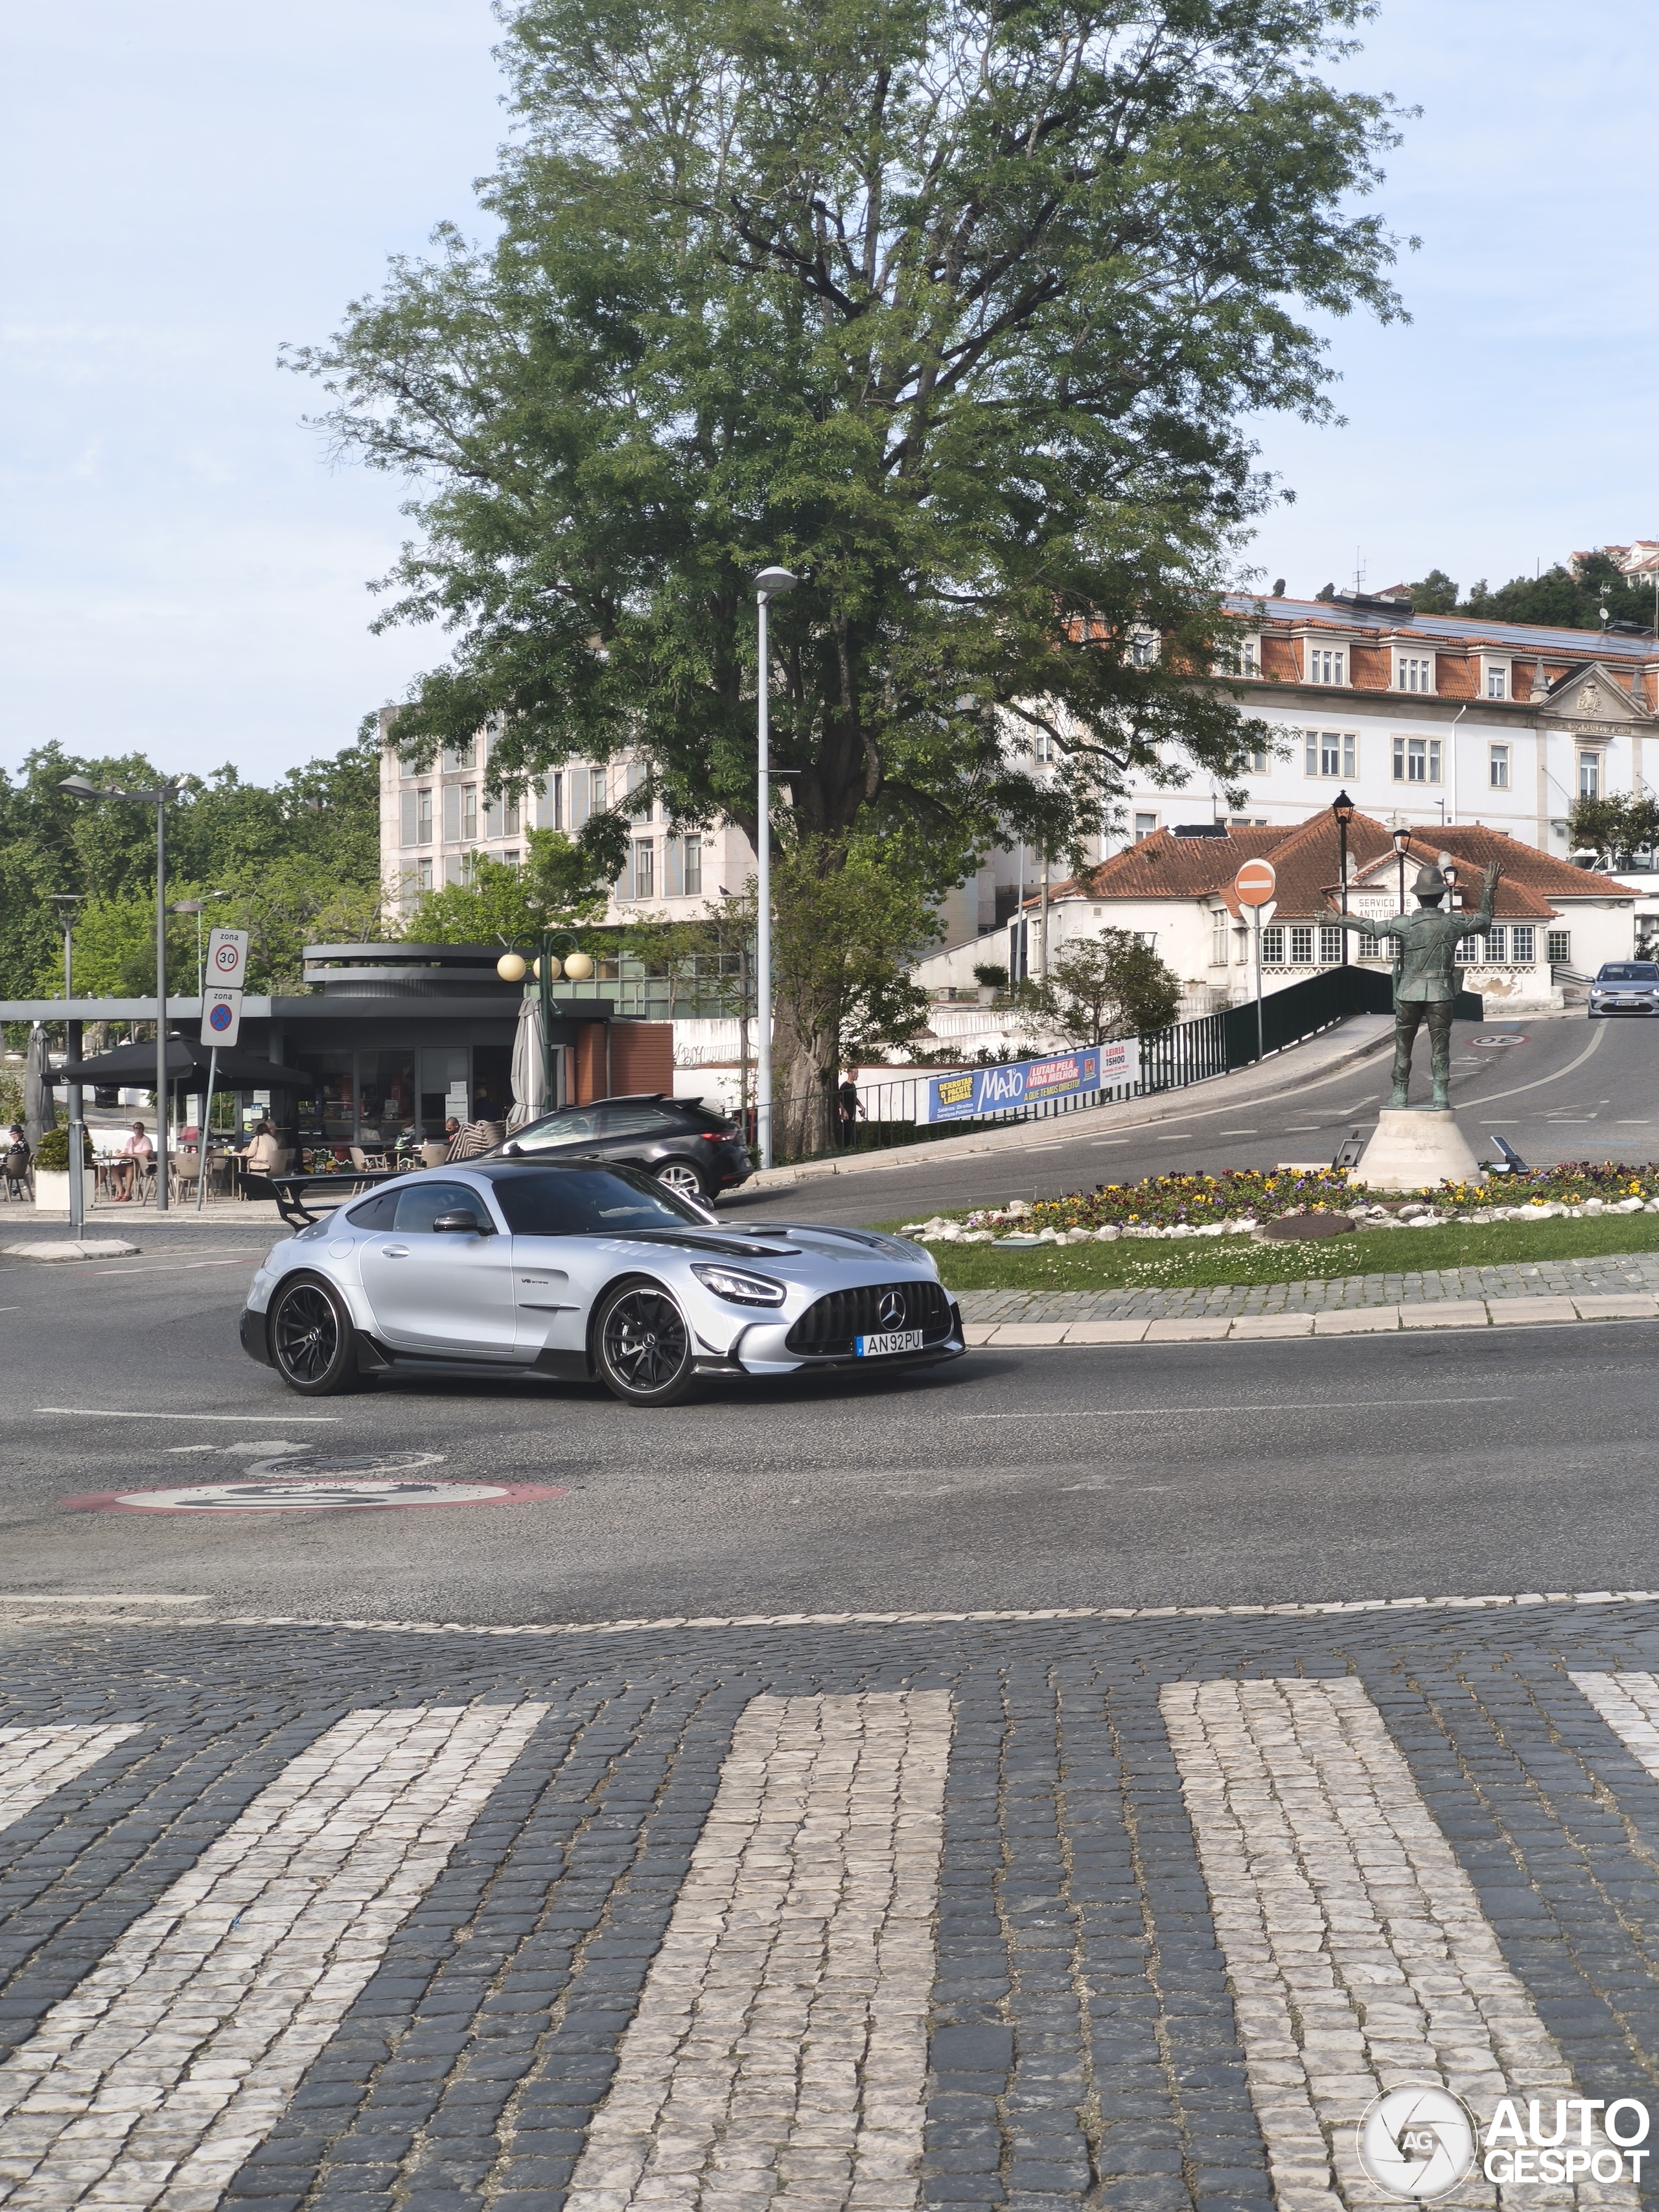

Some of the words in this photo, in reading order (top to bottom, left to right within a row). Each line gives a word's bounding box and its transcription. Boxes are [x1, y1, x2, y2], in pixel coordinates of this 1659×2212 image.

[219, 952, 235, 964] 30
[1476, 1036, 1521, 1045] 30
[1106, 1046, 1124, 1057] LEIRIA
[1106, 1055, 1125, 1066] 15H00
[1032, 1064, 1055, 1077] LUTAR
[1056, 1060, 1073, 1071] PELA
[1029, 1075, 1048, 1086] VIDA
[1049, 1067, 1078, 1082] MELHOR
[939, 1077, 973, 1091] DERROTAR
[947, 1084, 971, 1097] PACOTE
[944, 1091, 972, 1104] LABORAL
[1028, 1090, 1041, 1100] QUE
[1041, 1084, 1059, 1097] TEMOS
[868, 1331, 920, 1353] AN92PU
